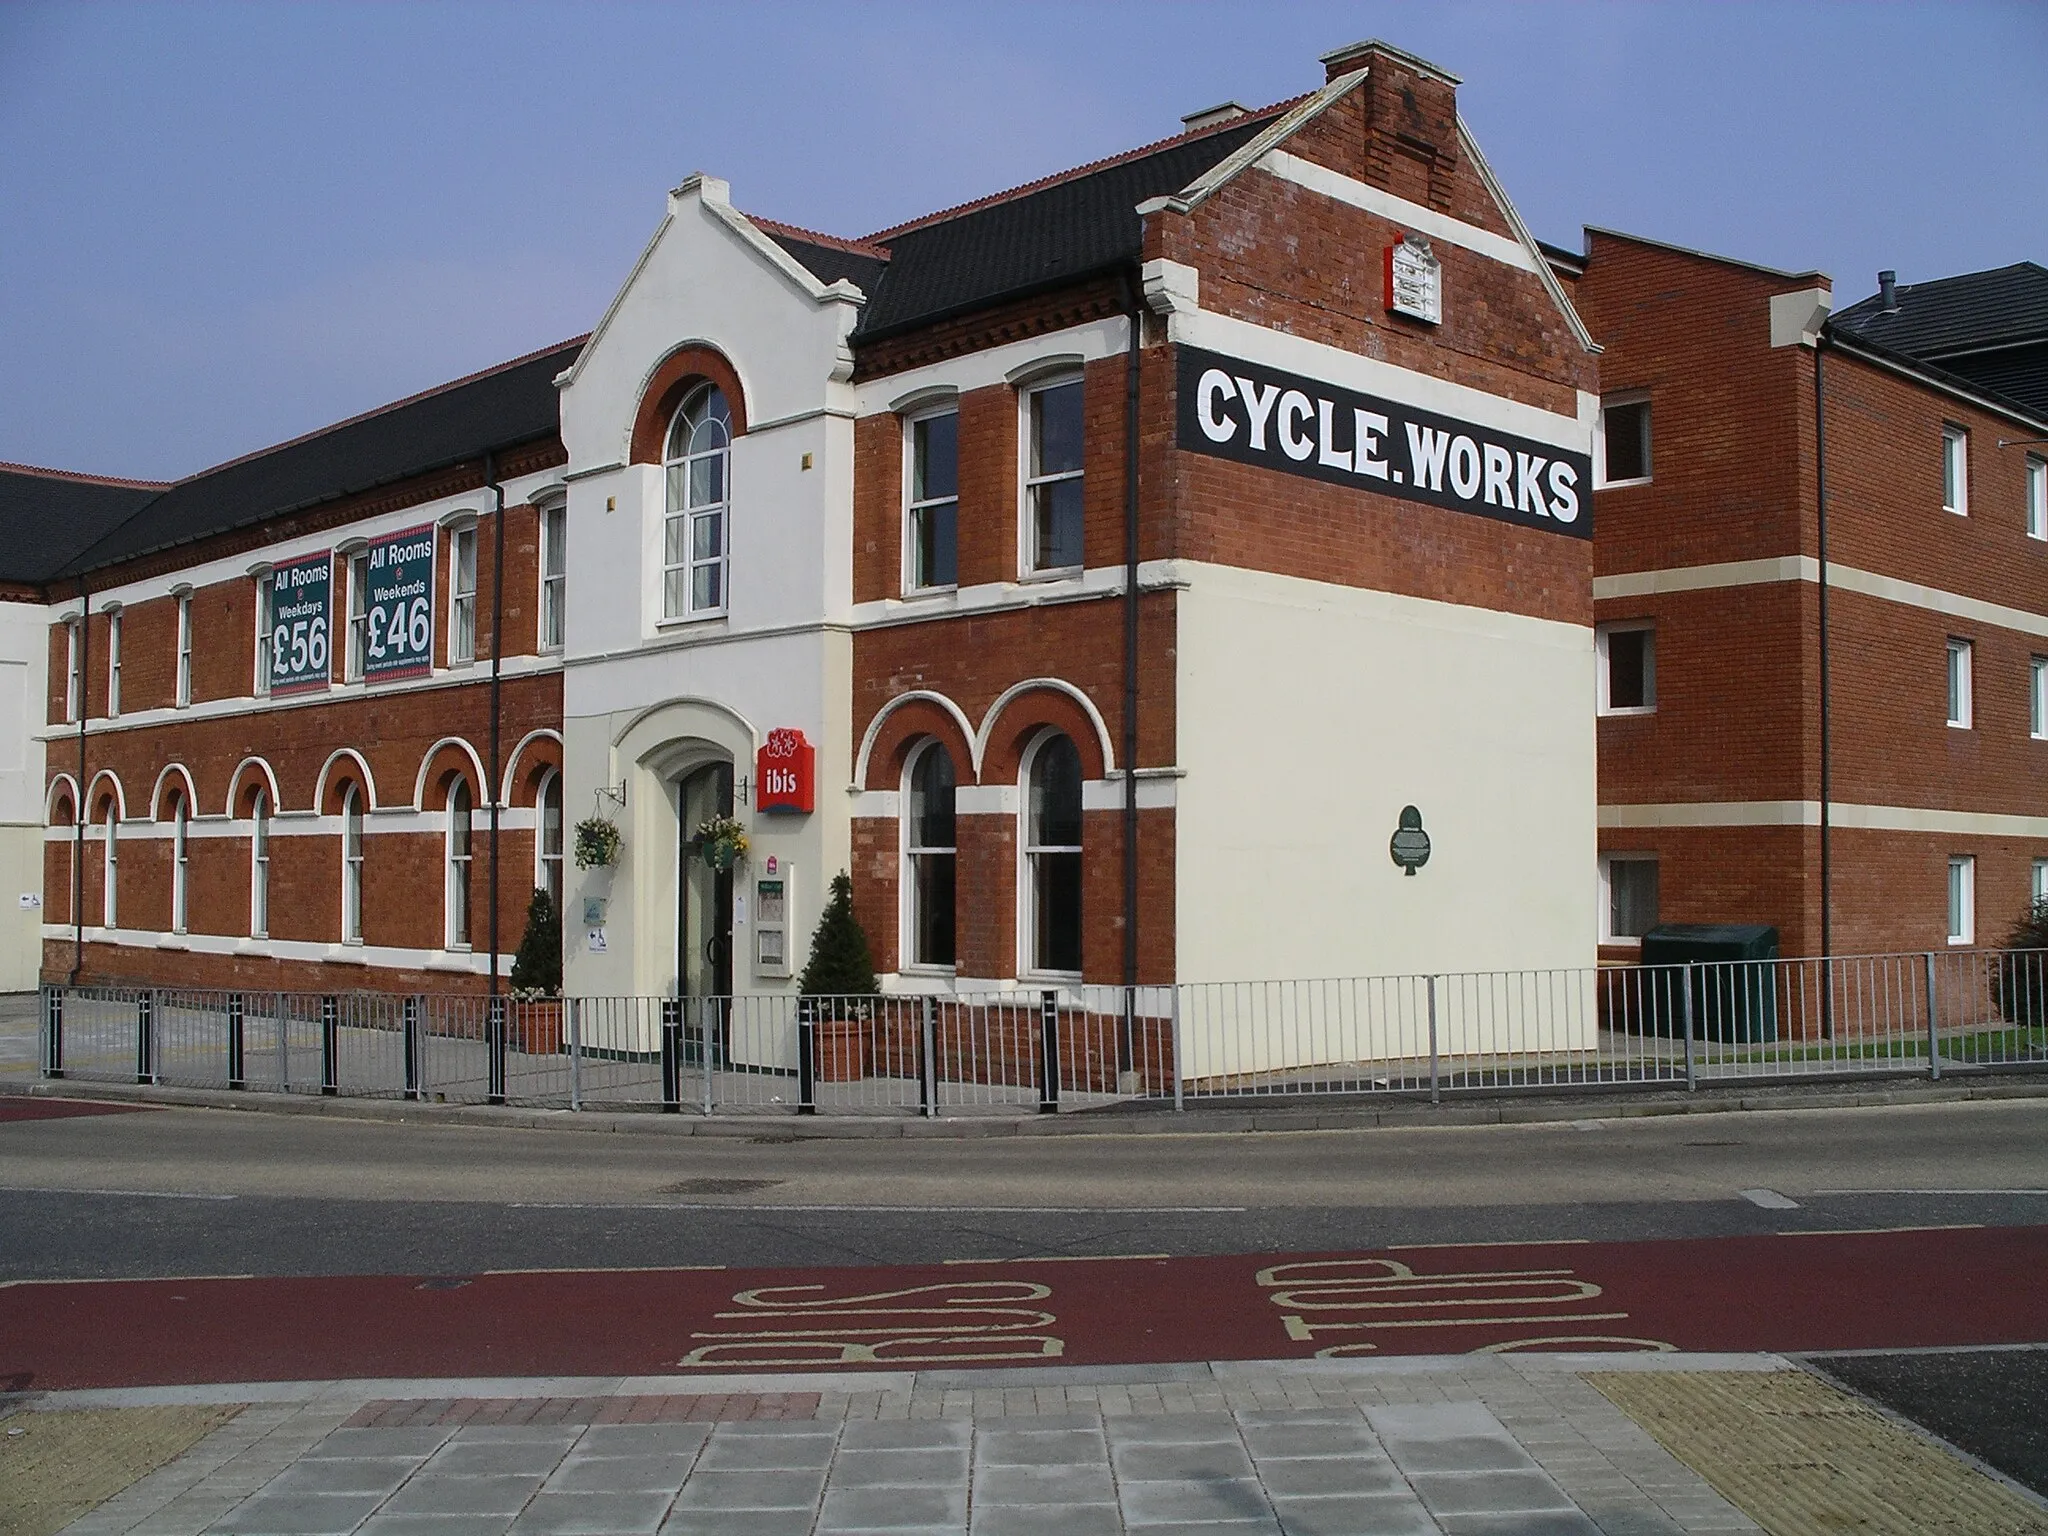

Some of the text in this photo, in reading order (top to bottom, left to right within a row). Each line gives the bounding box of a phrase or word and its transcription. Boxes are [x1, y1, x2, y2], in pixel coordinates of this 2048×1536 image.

[369, 540, 432, 570] All Rooms
[275, 565, 329, 591] All Rooms
[373, 579, 426, 602] Weekends
[278, 601, 323, 620] Weekdays
[368, 597, 430, 658] £46
[273, 616, 327, 675] £56
[766, 767, 797, 794] ibis
[679, 1281, 1065, 1369] BUS
